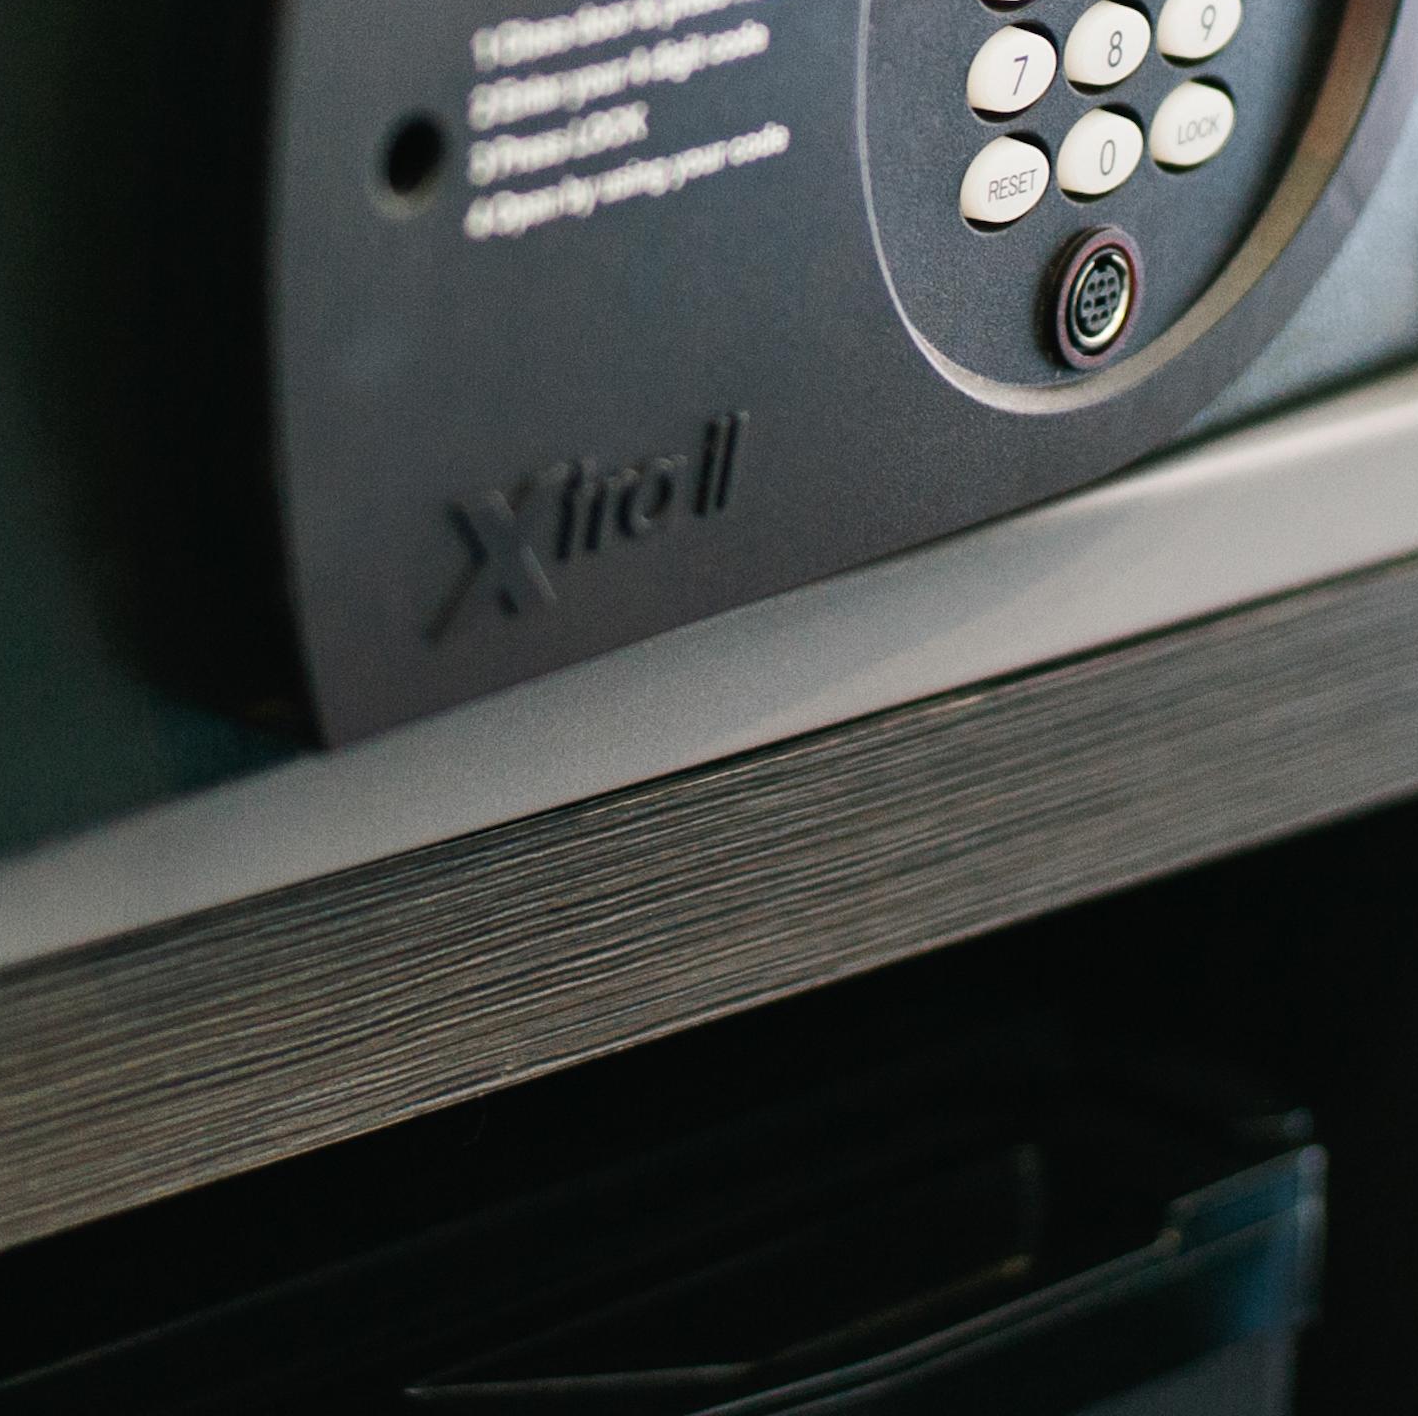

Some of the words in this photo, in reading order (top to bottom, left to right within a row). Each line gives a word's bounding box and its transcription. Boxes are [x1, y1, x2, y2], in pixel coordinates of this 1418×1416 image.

[706, 18, 771, 66] code
[1200, 3, 1218, 42] 9
[1106, 29, 1124, 69] 8
[1012, 54, 1030, 97] 7
[725, 121, 791, 168] code
[1177, 112, 1221, 146] LOCK
[1099, 138, 1117, 177] 0
[987, 167, 1039, 204] RESET
